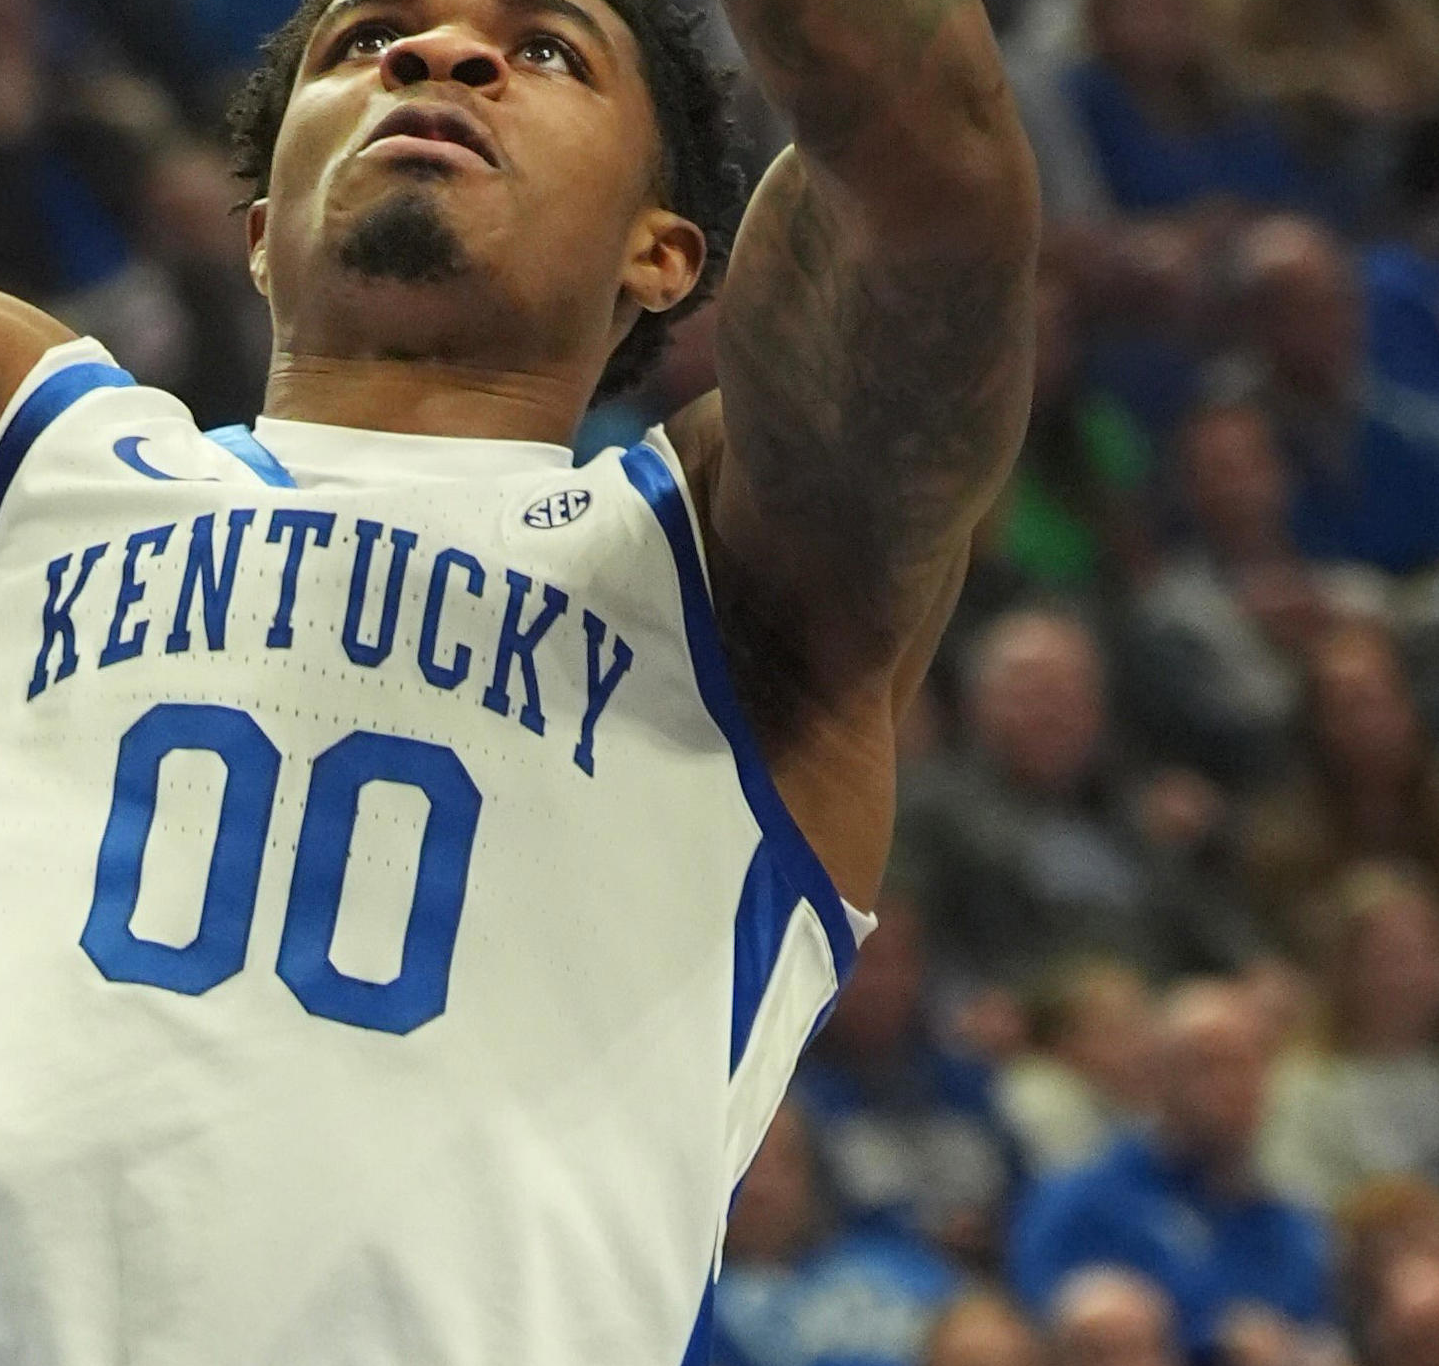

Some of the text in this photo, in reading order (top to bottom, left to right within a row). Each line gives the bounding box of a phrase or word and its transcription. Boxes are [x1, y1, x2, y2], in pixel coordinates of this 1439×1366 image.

[26, 507, 635, 778] KENTUCKY
[523, 490, 590, 529] SEC
[78, 702, 483, 1036] 00
